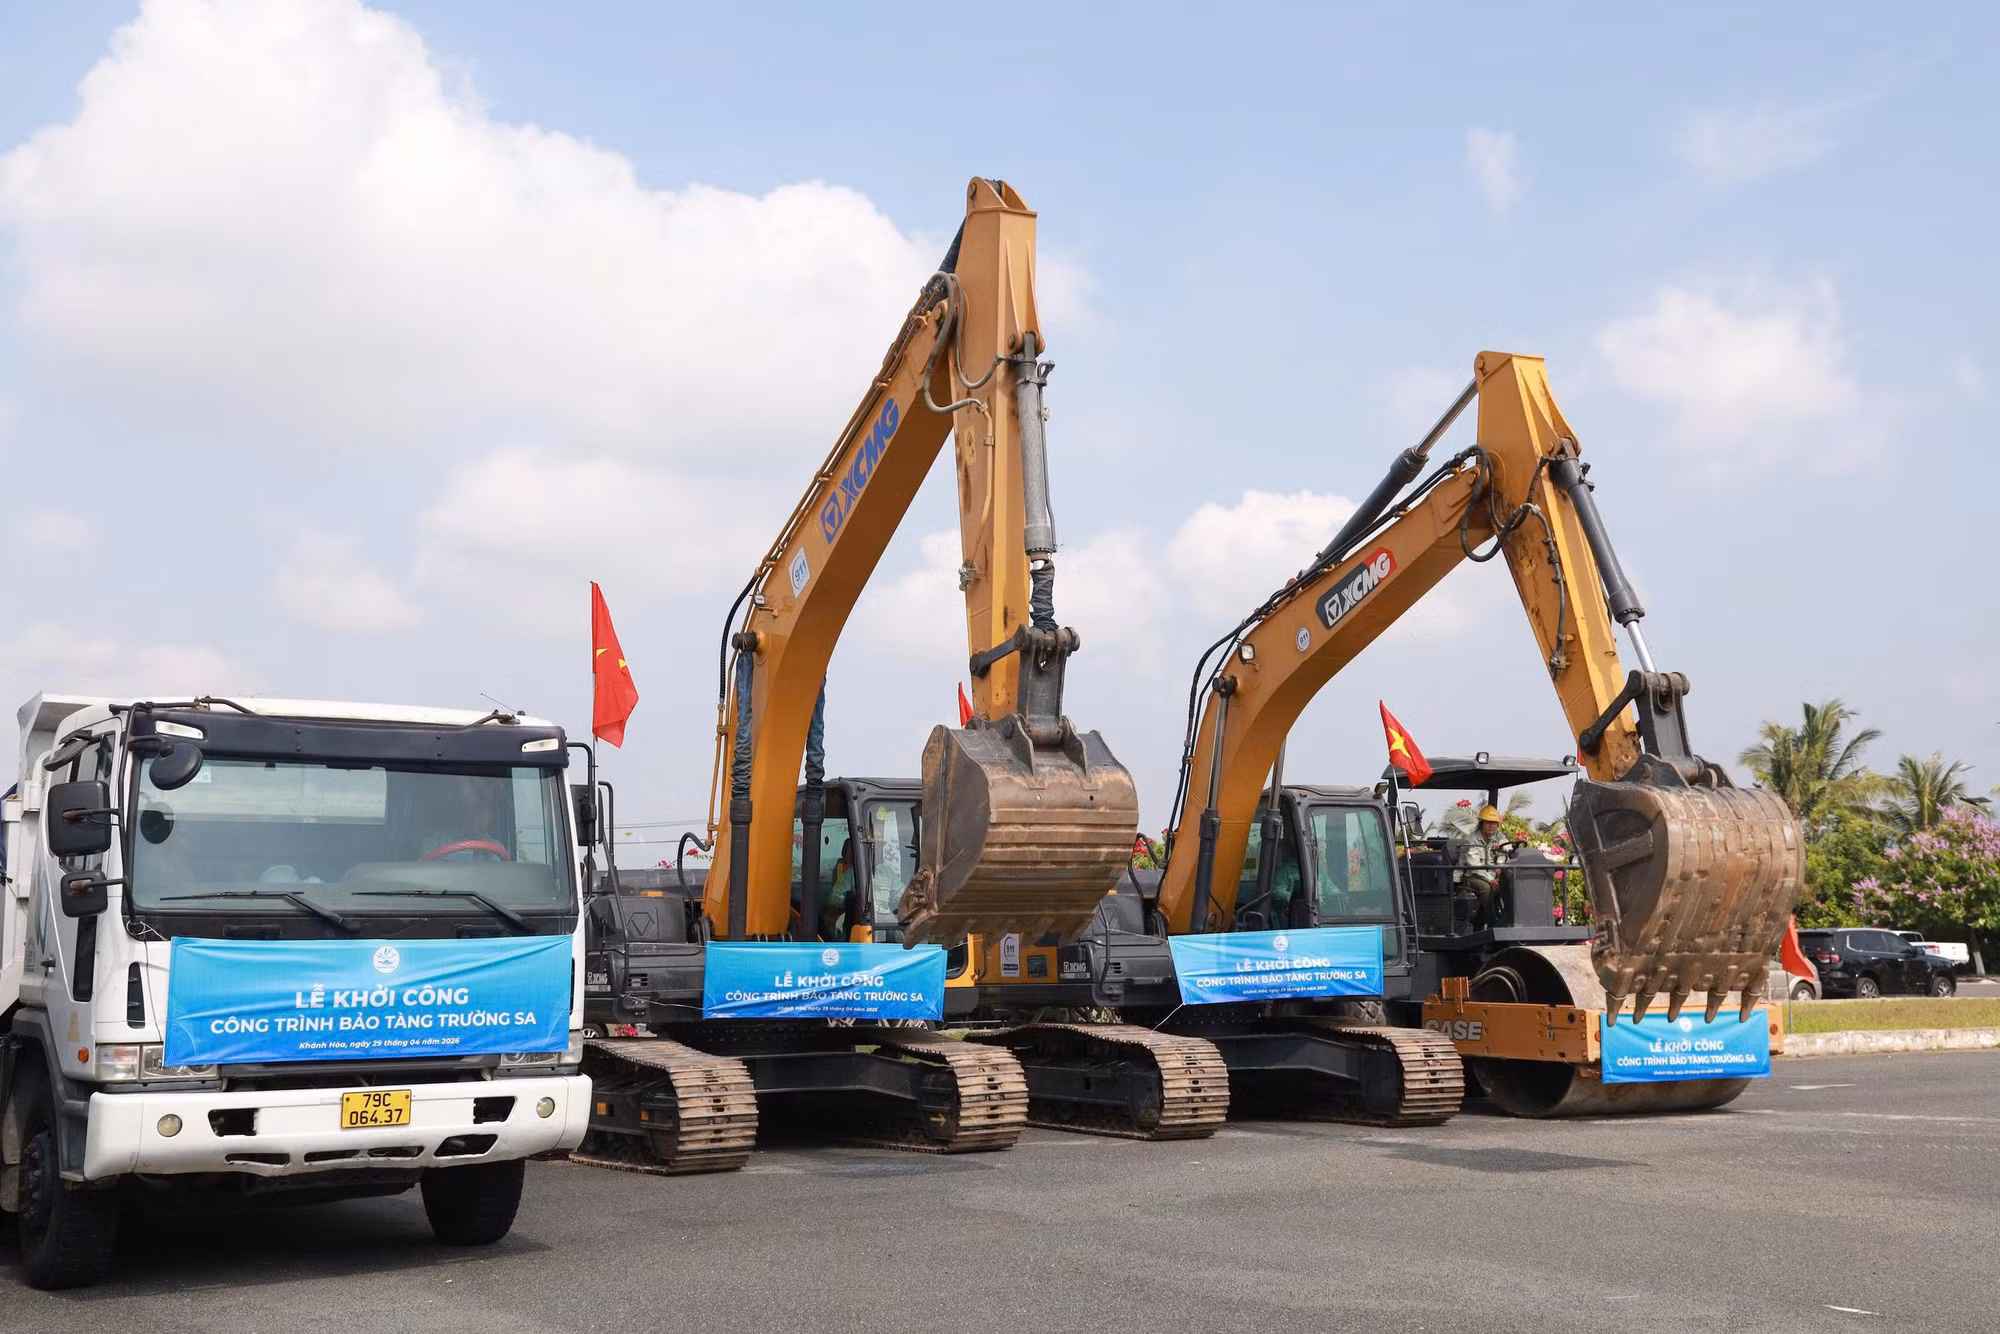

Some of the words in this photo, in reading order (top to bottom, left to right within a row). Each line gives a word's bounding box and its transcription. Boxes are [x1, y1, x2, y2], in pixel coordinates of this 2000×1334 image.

[839, 397, 899, 518] XCMG
[1340, 552, 1390, 614] XCMG
[1293, 956, 1330, 968] CÔNG
[775, 970, 793, 987] LỄ
[797, 972, 836, 987] KHỞI
[840, 973, 884, 987] CÔNG
[1196, 976, 1226, 987] CÔNG
[1227, 974, 1259, 985] TRÌNH
[1261, 972, 1283, 983] BẢO
[1286, 971, 1313, 982] TÀNG
[1314, 970, 1353, 980] TRƯỜNG
[1354, 971, 1367, 979] SA
[295, 983, 325, 1009] LỄ
[333, 984, 395, 1008] KHỞI
[402, 985, 469, 1007] CÔNG
[725, 990, 760, 1001] CÔNG
[763, 990, 799, 1001] TRÌNH
[801, 990, 827, 1000] BẢO
[830, 990, 861, 1001] TÀNG
[864, 990, 908, 1002] TRƯỜNG
[910, 992, 924, 1002] SA
[210, 1016, 269, 1034] CÔNG
[274, 1014, 333, 1032] TRÌNH
[339, 1012, 379, 1030] BẢO
[385, 1012, 433, 1029] TÀNG
[437, 1010, 510, 1027] TRƯỜNG
[514, 1012, 536, 1025] SA
[299, 1041, 327, 1049] Khánh
[349, 1040, 370, 1049] ngày
[384, 1038, 408, 1047] tháng
[441, 1037, 460, 1045] 2026
[1694, 1038, 1724, 1051] CÔNG
[1617, 1056, 1642, 1067] CÔNG
[1643, 1055, 1668, 1066] TRÌNH
[1687, 1054, 1710, 1064] TÀNG
[1745, 1054, 1756, 1063] SA
[363, 1093, 391, 1108] 79C
[350, 1108, 403, 1125] 064.37
